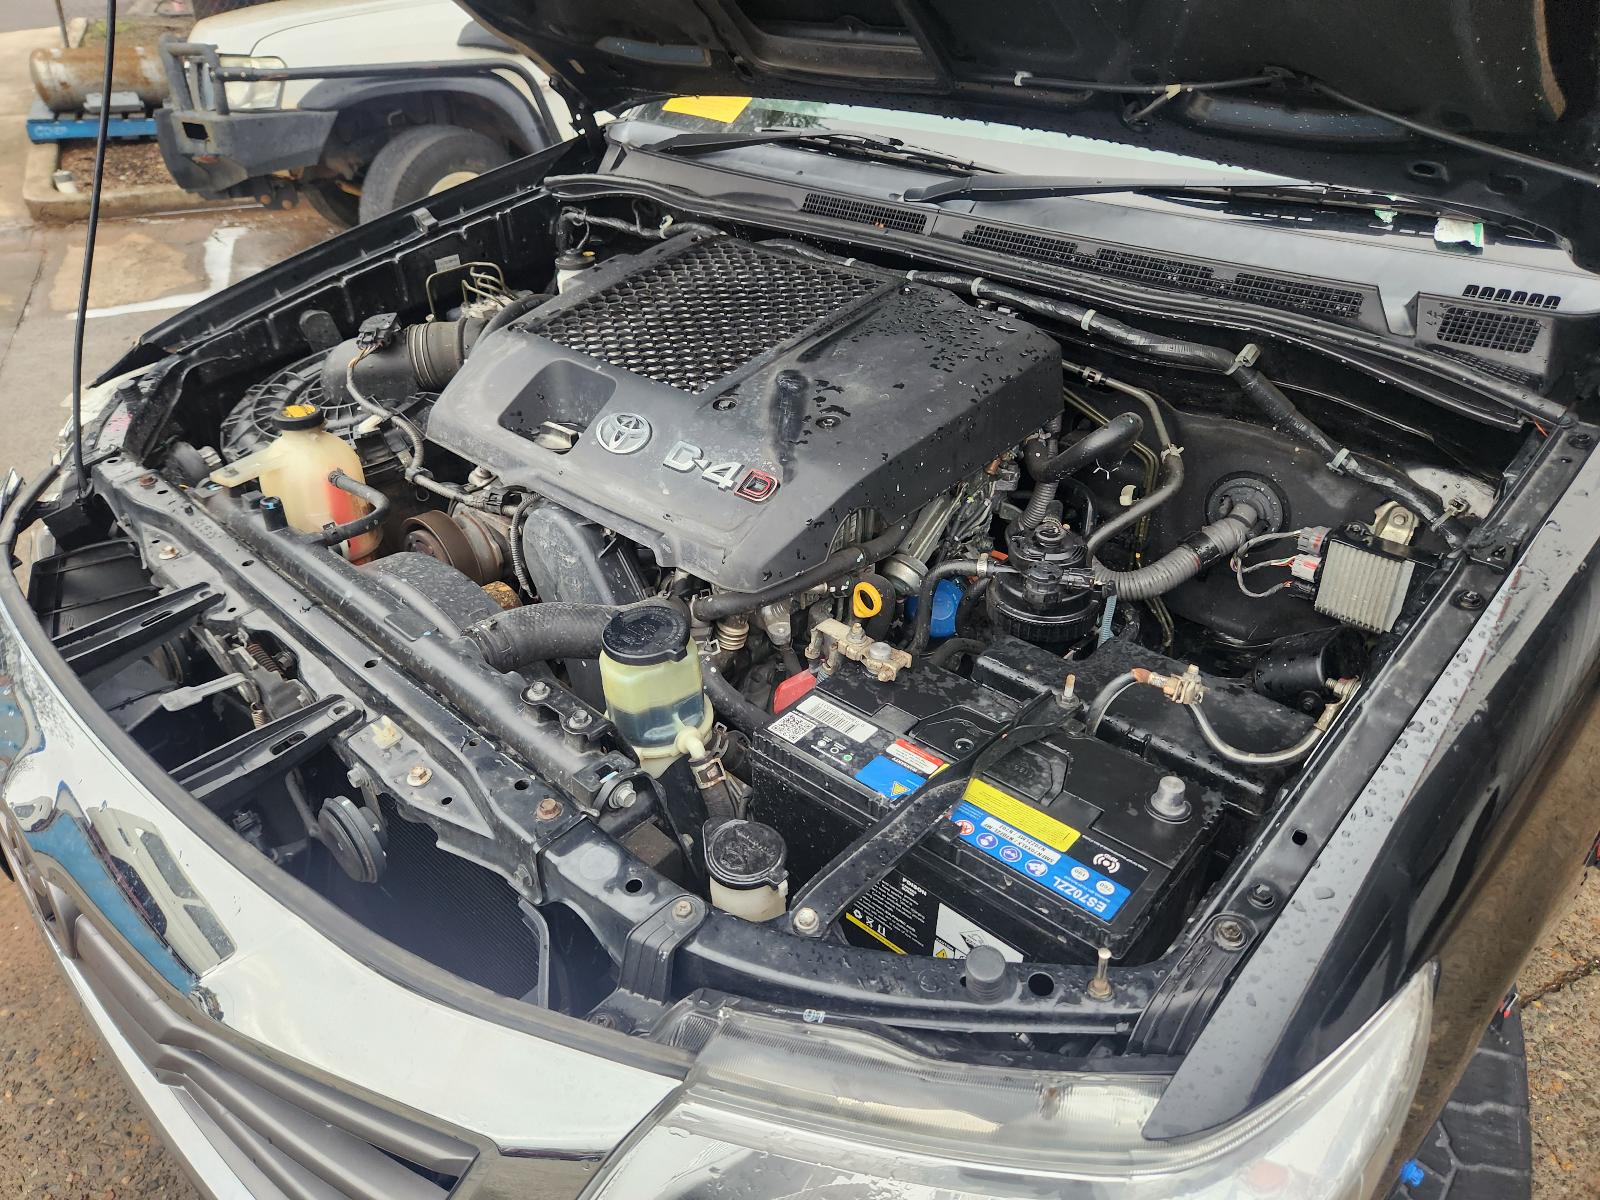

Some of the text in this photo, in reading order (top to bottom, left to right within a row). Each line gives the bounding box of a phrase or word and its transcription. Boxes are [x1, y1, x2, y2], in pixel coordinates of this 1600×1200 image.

[662, 440, 780, 503] D-4D
[902, 877, 927, 896] POISON
[1053, 875, 1107, 913] ES70ZZL
